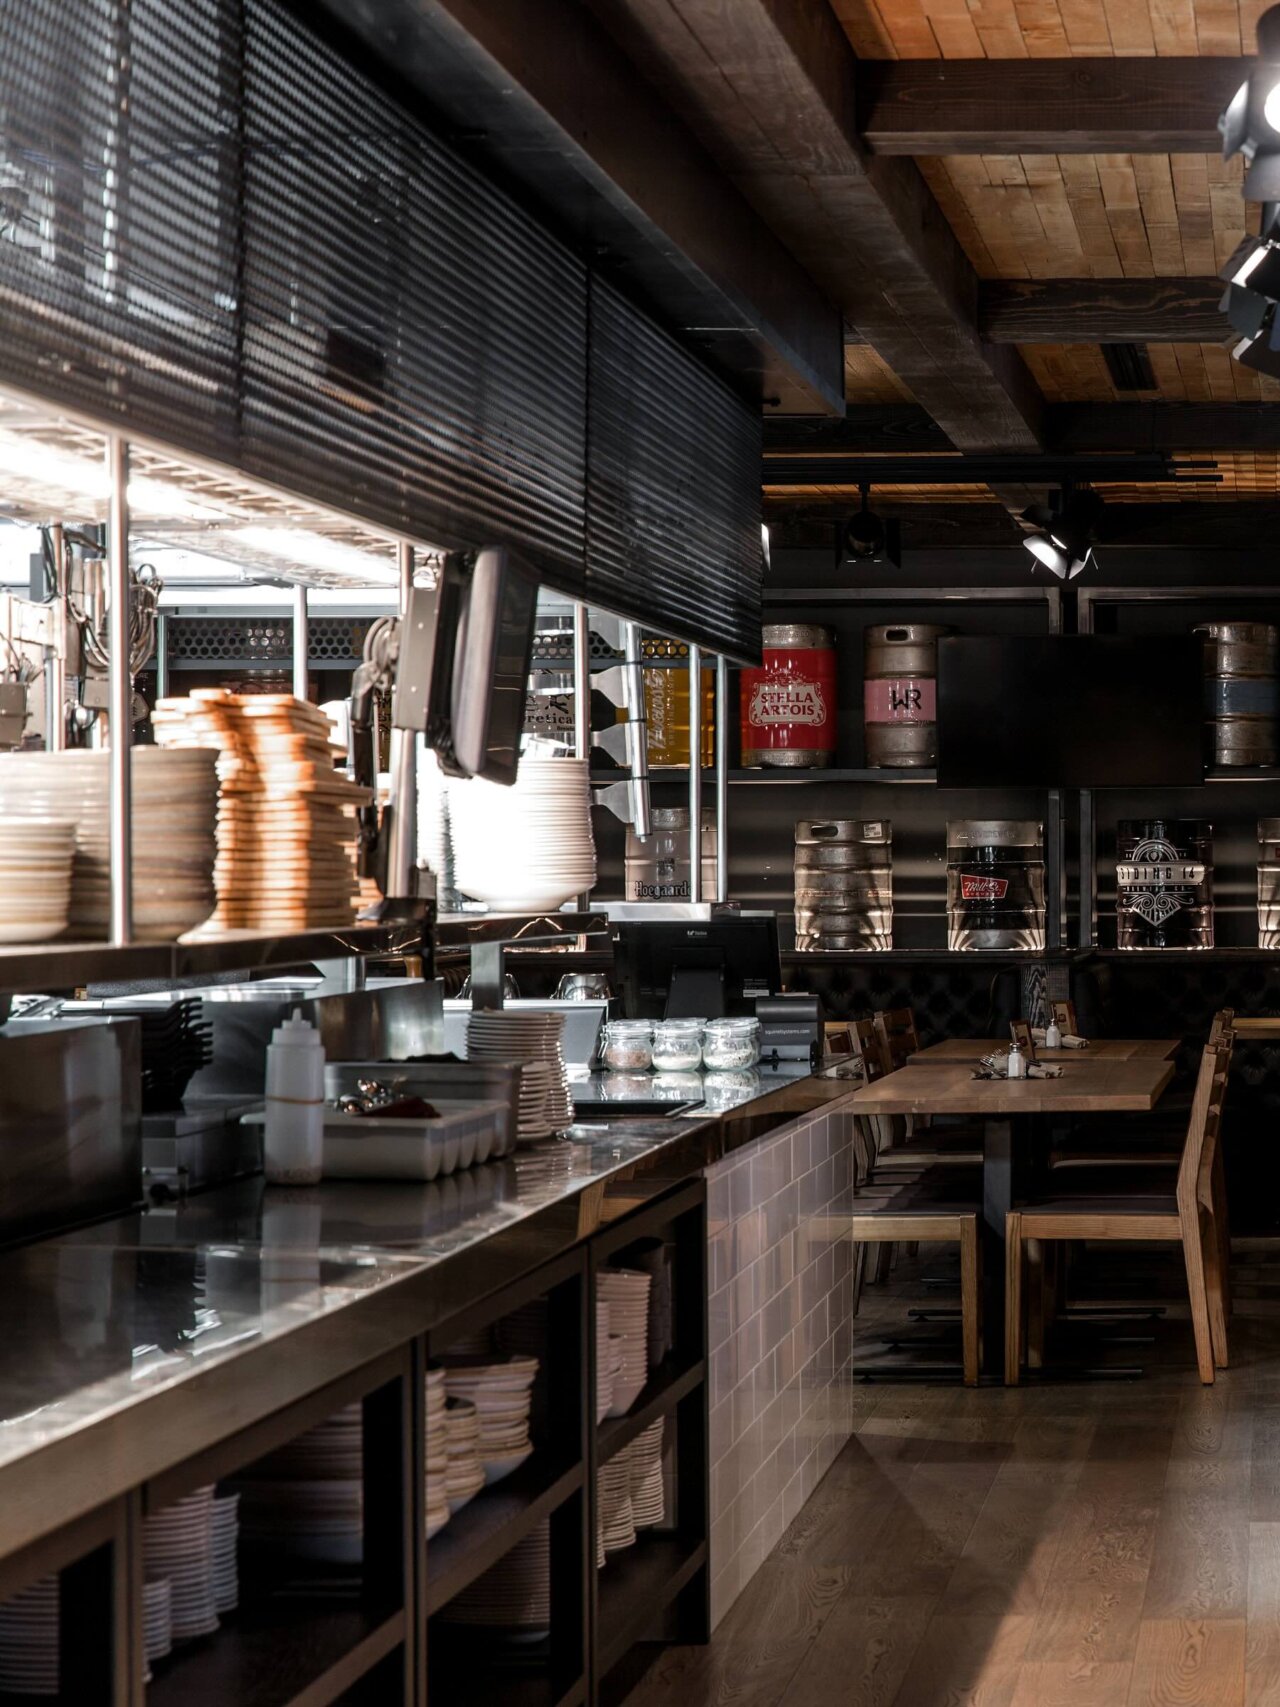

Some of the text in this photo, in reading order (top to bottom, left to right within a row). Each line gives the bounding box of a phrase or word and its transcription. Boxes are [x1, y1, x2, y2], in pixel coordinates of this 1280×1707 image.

[760, 692, 815, 704] STELLA
[760, 704, 816, 716] ARTOIS
[1120, 867, 1195, 879] SIDING 14
